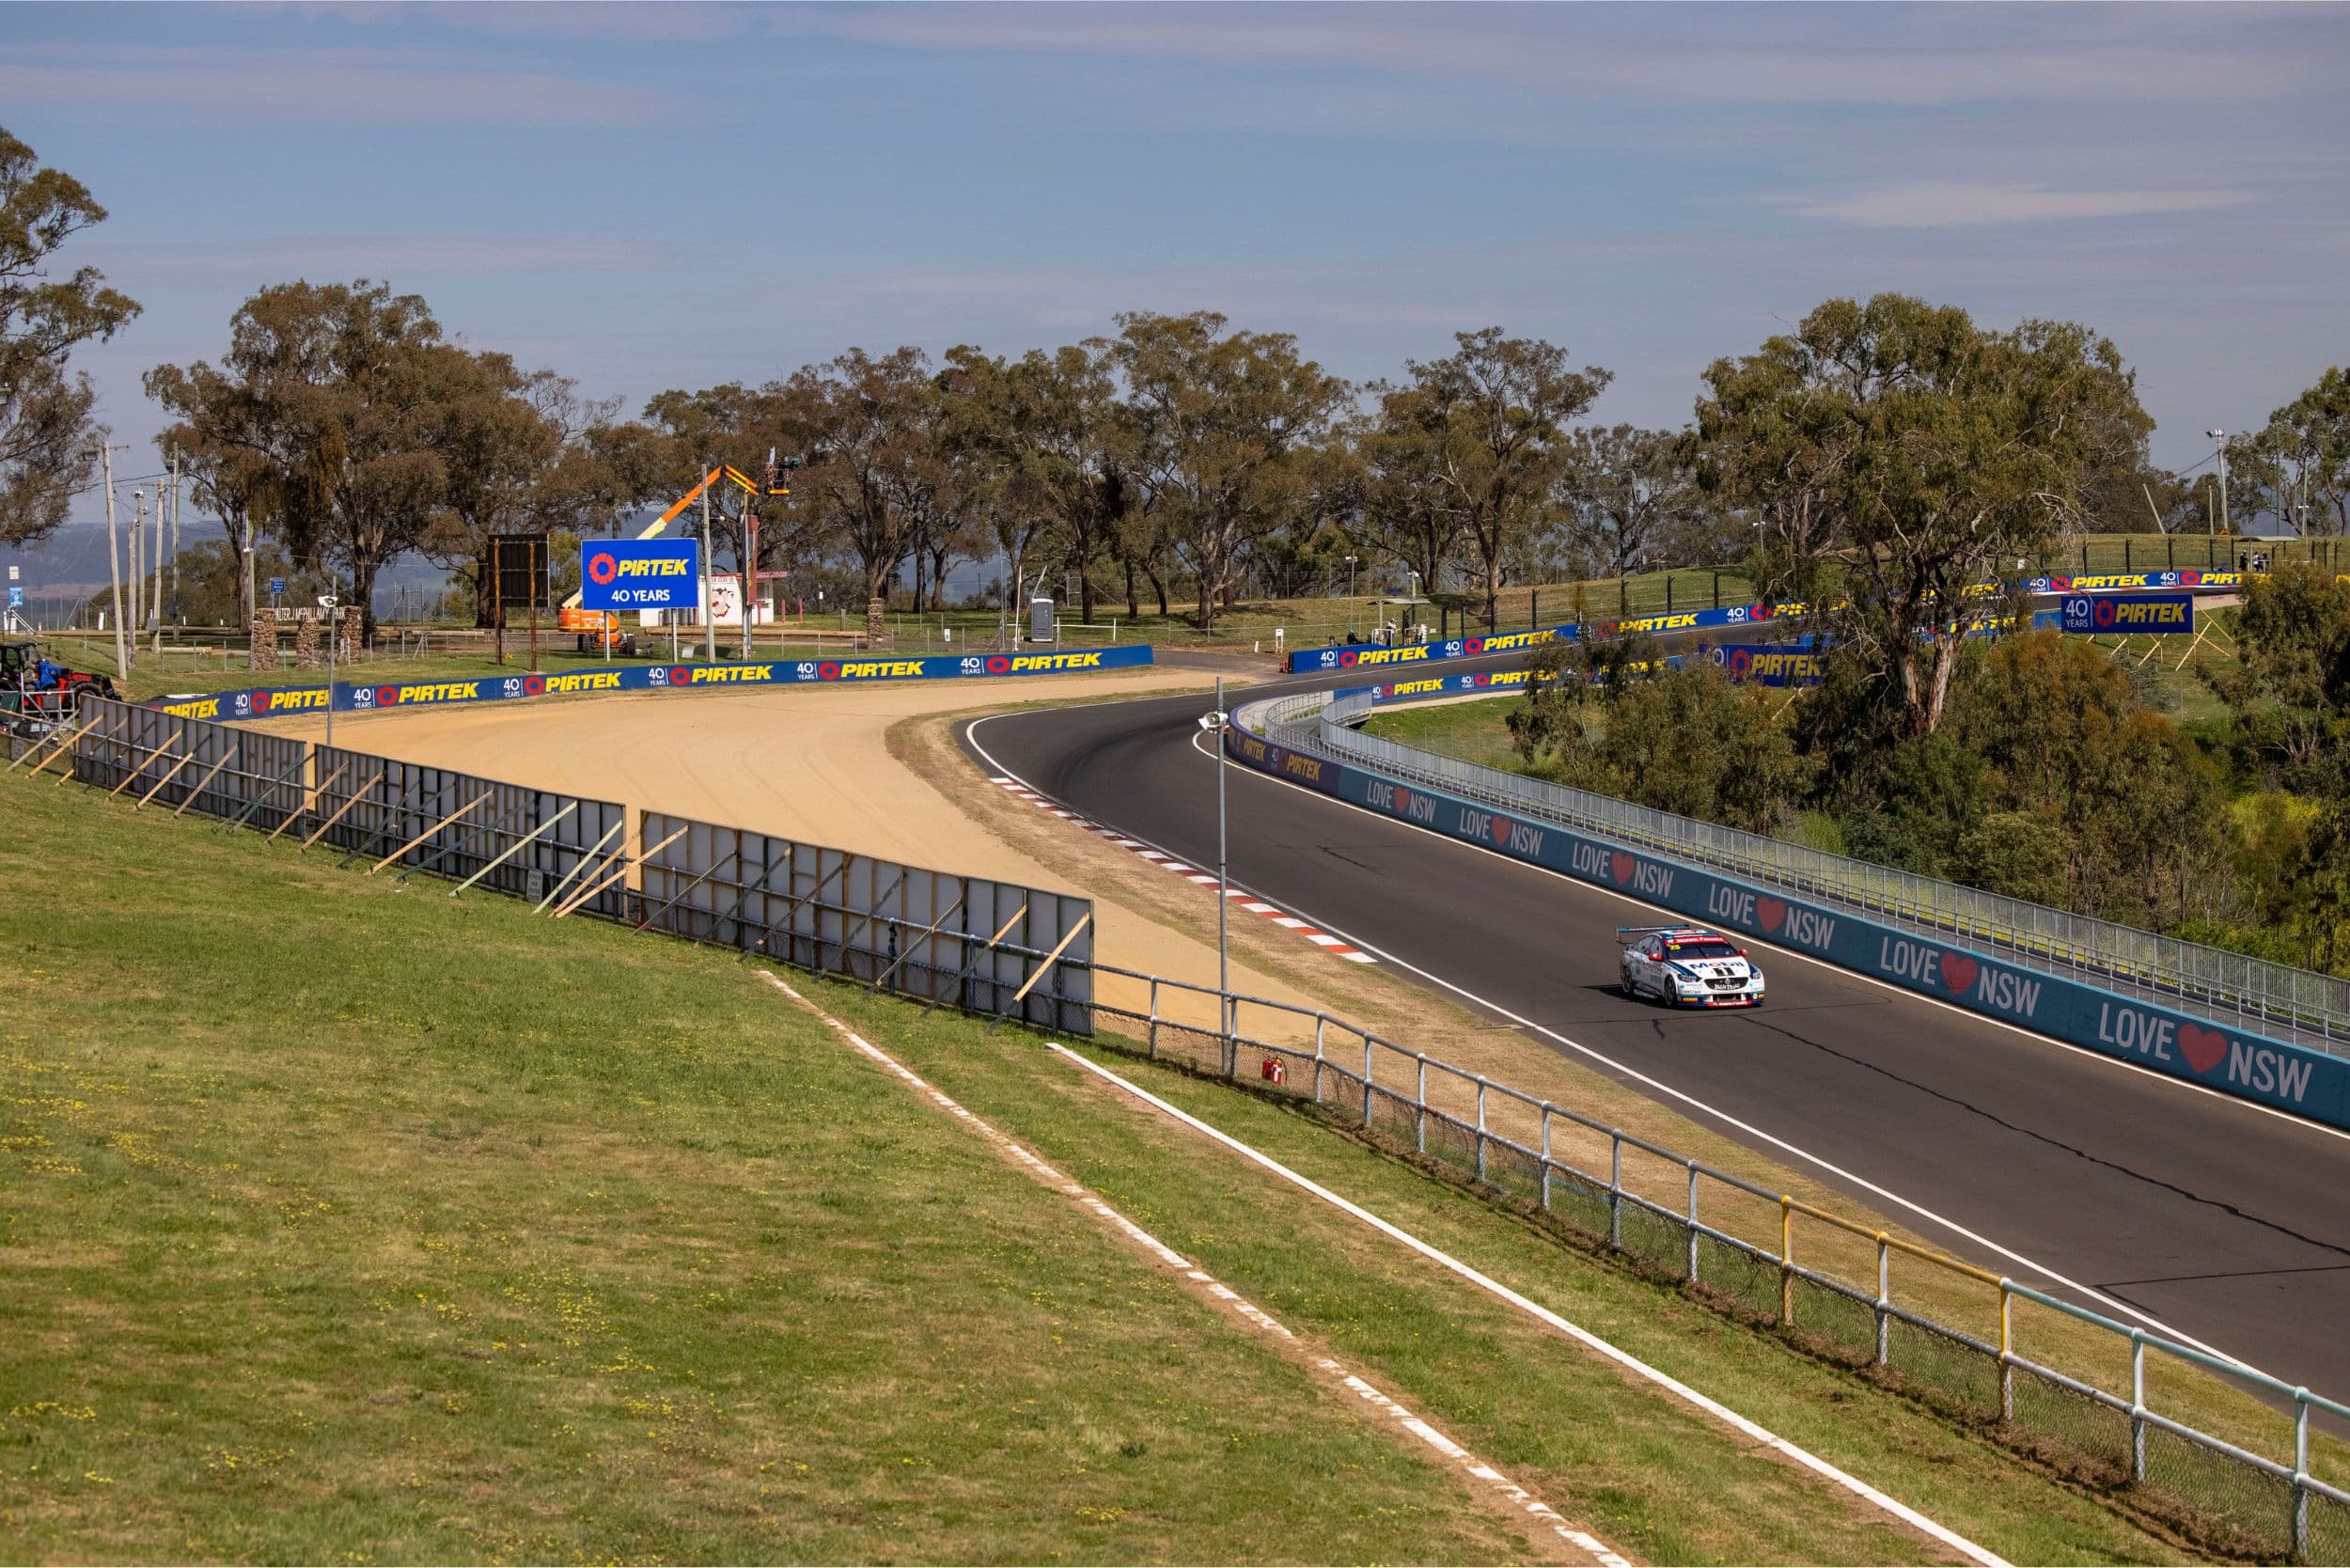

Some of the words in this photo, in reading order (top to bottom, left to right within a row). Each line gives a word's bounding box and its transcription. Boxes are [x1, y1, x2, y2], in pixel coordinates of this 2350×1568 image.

[618, 558, 689, 576] PIRTEK
[2029, 578, 2046, 588] 40
[2072, 573, 2148, 588] PIRTEK
[2160, 572, 2176, 582] 40
[611, 590, 630, 602] 40
[632, 589, 670, 602] YEARS
[1727, 607, 1745, 617] 40
[2065, 600, 2088, 618] 40
[2115, 603, 2187, 623] PIRTEK
[1618, 613, 1699, 633] PIRTEK
[2065, 619, 2089, 629] YEARS
[1445, 641, 1460, 652] 40
[1483, 629, 1557, 651] PIRTEK
[960, 657, 979, 668] 40
[1011, 652, 1103, 671] PIRTEK
[1320, 651, 1335, 663] 40
[1357, 646, 1430, 665] PIRTEK
[1751, 653, 1821, 677] PIRTEK
[649, 667, 664, 680] 40
[691, 666, 773, 682] PIRTEK
[797, 663, 813, 674] 40
[840, 661, 925, 678] PIRTEK
[503, 679, 519, 691] 40
[545, 672, 622, 692] PIRTEK
[1393, 678, 1444, 696] PIRTEK
[1461, 676, 1472, 684] 40
[235, 695, 248, 708] 40
[353, 689, 371, 701] 40
[399, 682, 478, 703] PIRTEK
[1287, 754, 1322, 781] PIRTEK
[1367, 780, 1393, 809] LOVE
[1409, 792, 1436, 823] NSW
[1459, 808, 1492, 839] LOVE
[1511, 823, 1543, 856] NSW
[1572, 842, 1610, 879] LOVE
[1634, 862, 1674, 898] NSW
[1708, 884, 1755, 926] LOVE
[1785, 906, 1835, 950] NSW
[1880, 936, 1939, 986] LOVE
[1978, 965, 2041, 1017] NSW
[2099, 1002, 2175, 1061] LOVE
[2228, 1041, 2312, 1103] NSW
